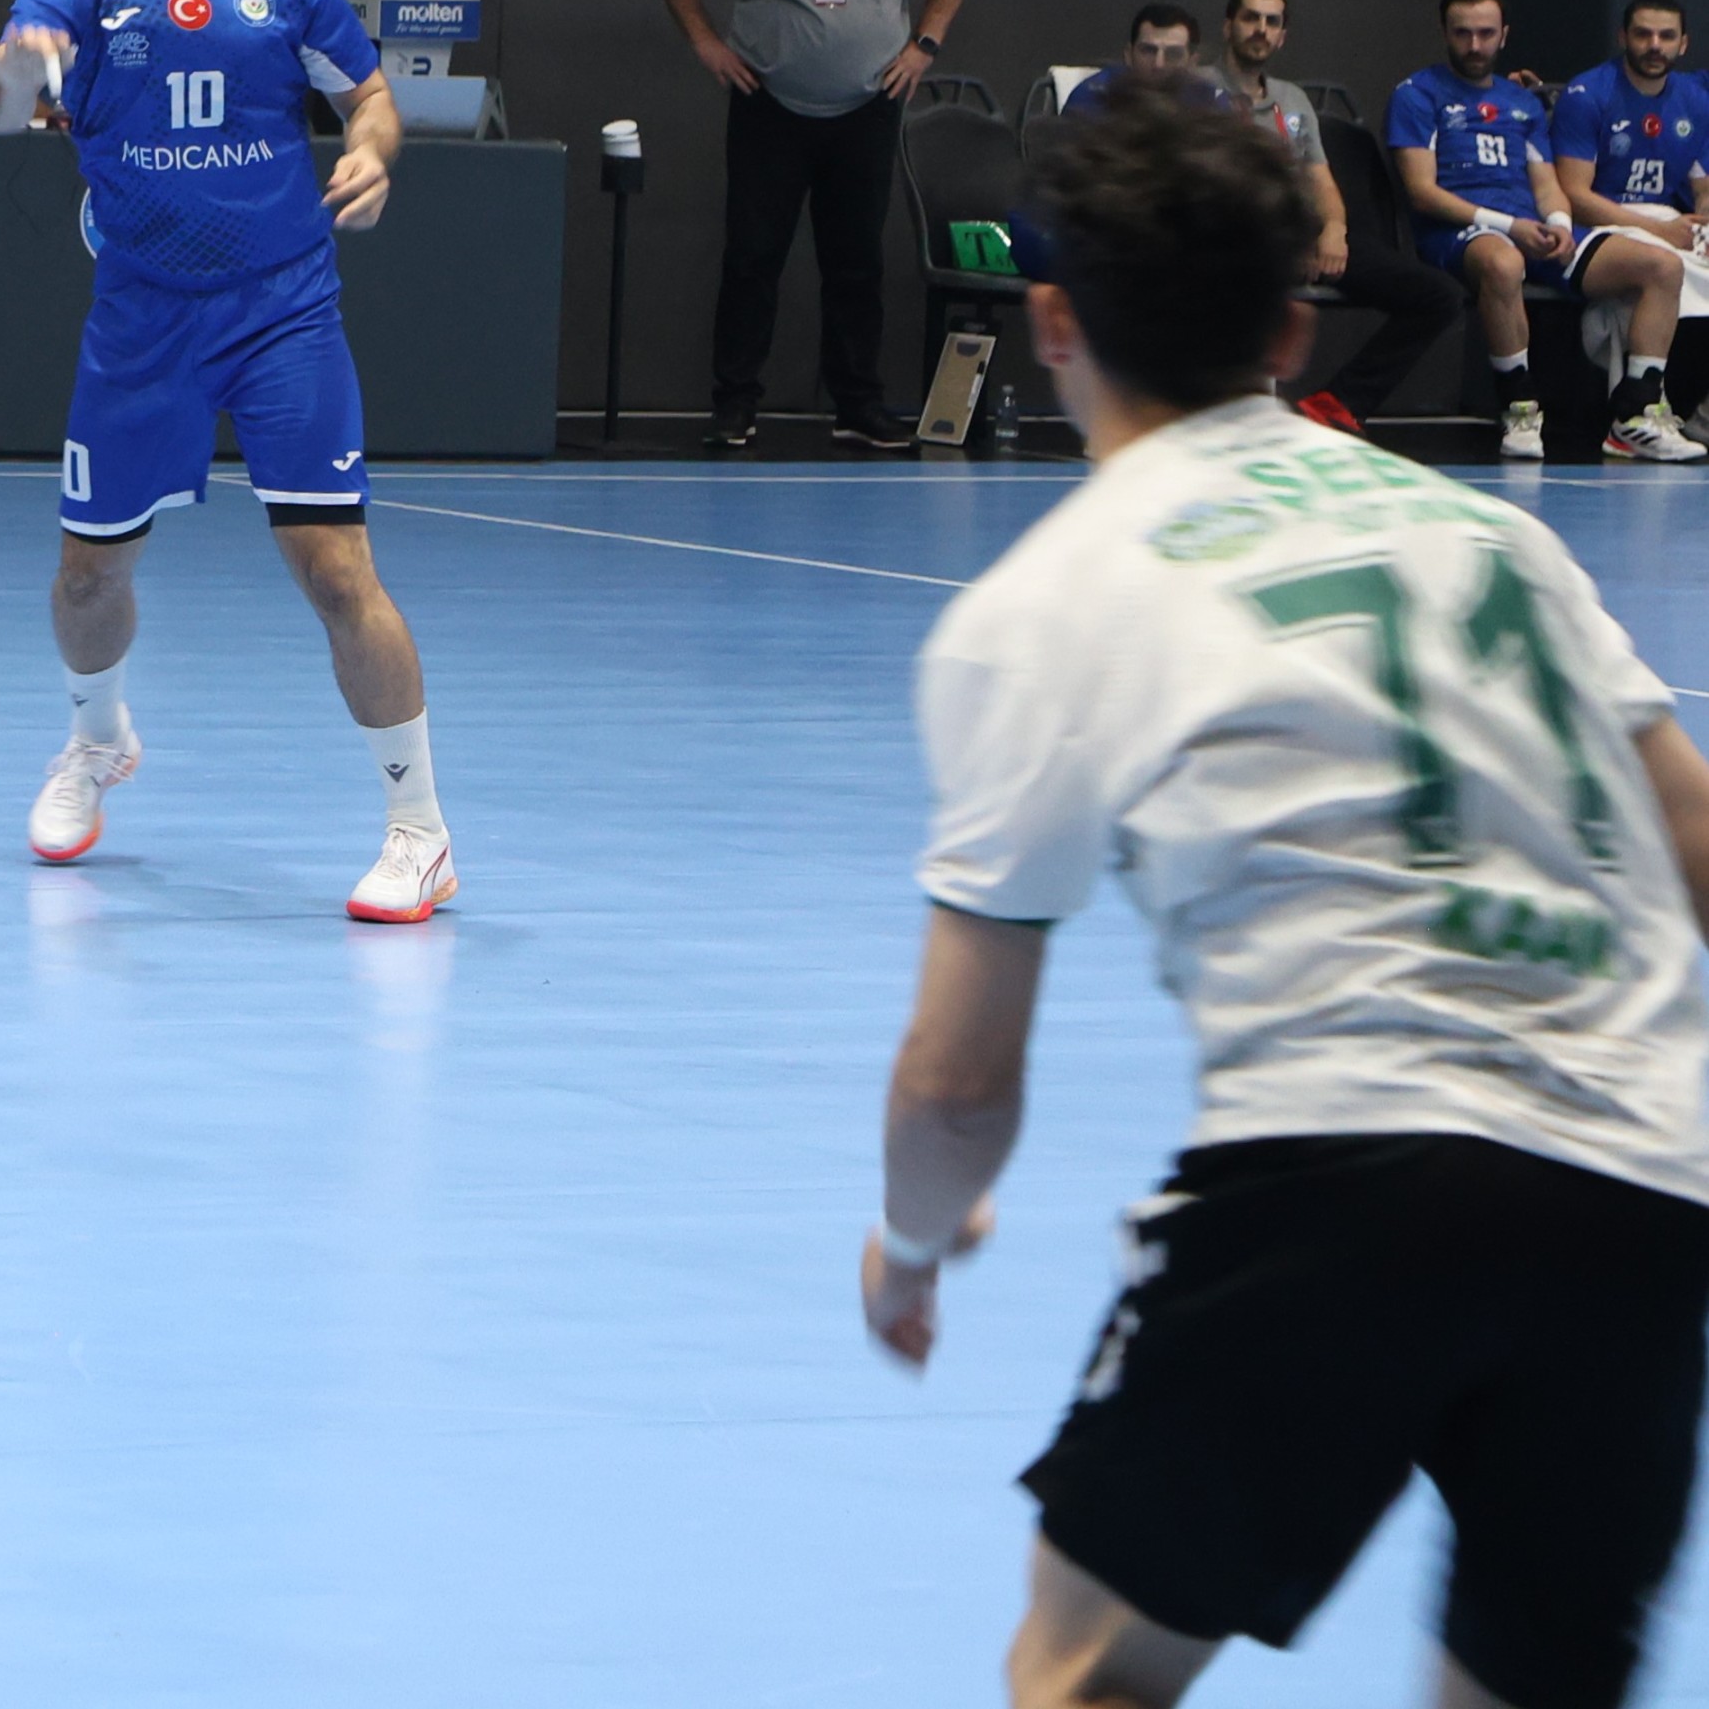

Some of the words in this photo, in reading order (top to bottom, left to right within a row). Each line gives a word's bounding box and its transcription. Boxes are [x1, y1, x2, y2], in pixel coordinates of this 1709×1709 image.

[398, 2, 464, 23] molten
[166, 70, 225, 130] 10
[1625, 158, 1665, 195] 23
